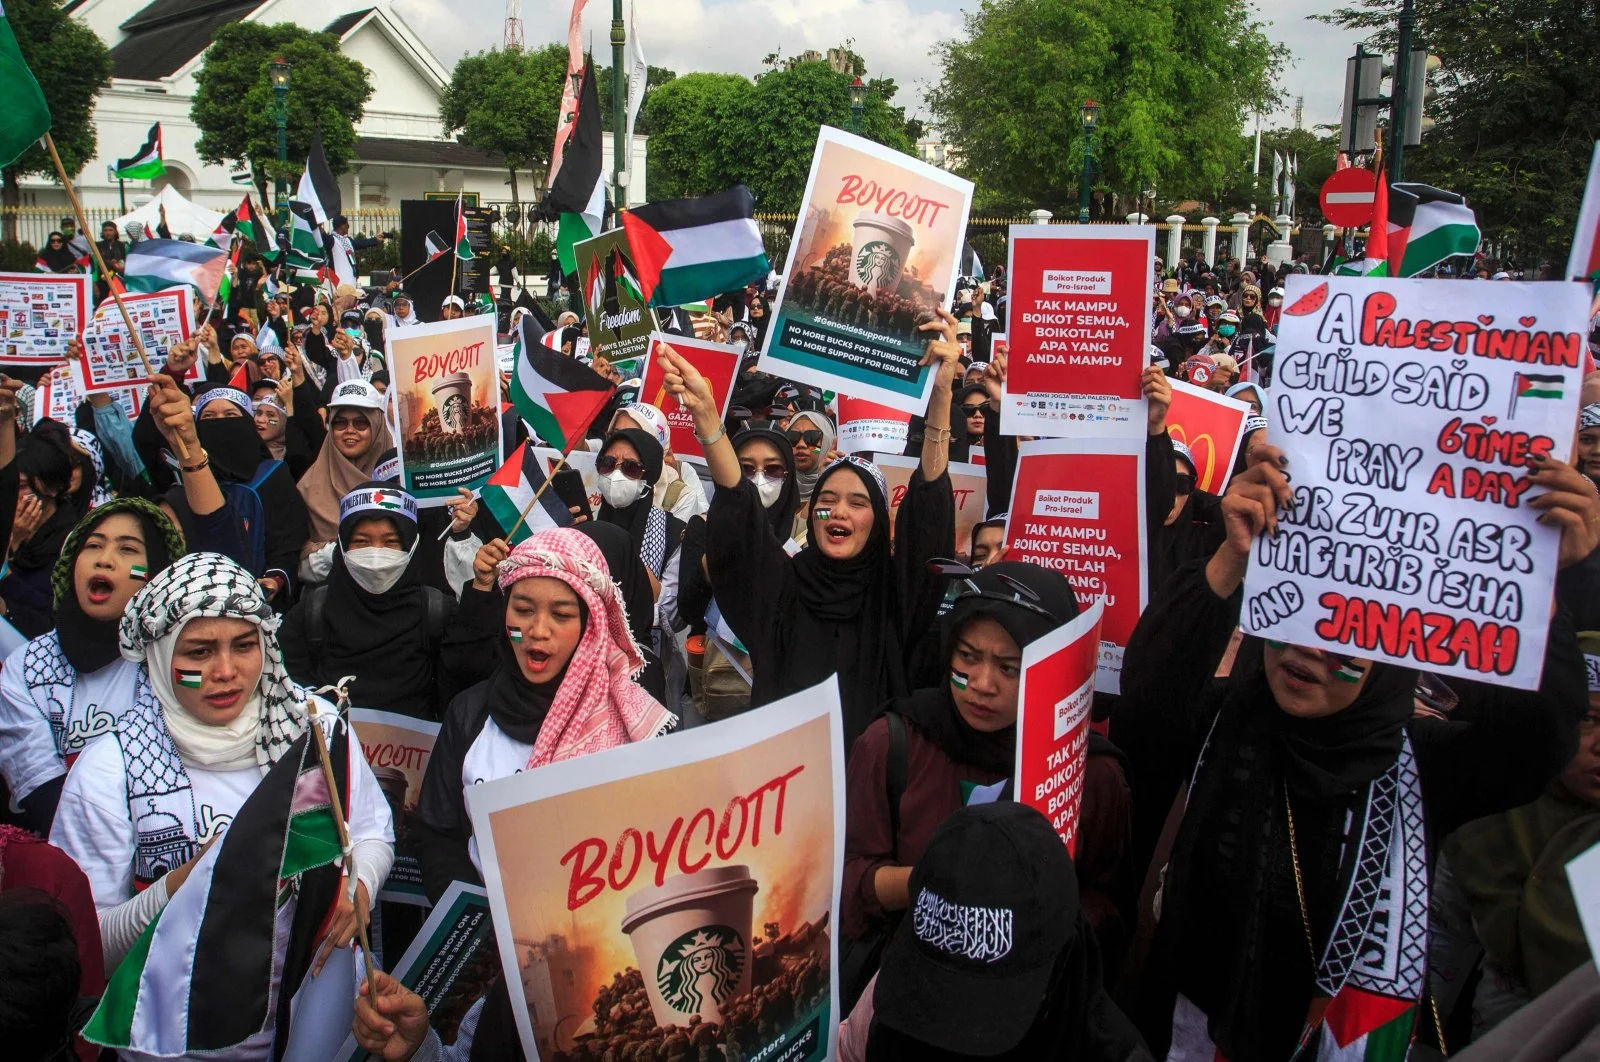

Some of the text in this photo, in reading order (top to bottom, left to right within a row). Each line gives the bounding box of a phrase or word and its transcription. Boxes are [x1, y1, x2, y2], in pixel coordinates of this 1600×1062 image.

[836, 175, 950, 228] BOYCOTT
[1047, 274, 1106, 283] Boikot Produk
[1056, 283, 1096, 291] Pro-Israel
[599, 306, 641, 331] Freedom
[1034, 299, 1118, 313] TAK MAMPU
[1319, 292, 1356, 345] A
[813, 315, 902, 346] #GenocideSupporters
[1022, 313, 1130, 328] BOIKOT SEMUA,
[618, 338, 631, 347] DUA
[632, 336, 646, 345] FOR
[788, 325, 802, 334] NO
[802, 329, 826, 342] MORE
[854, 343, 871, 354] FOR
[1035, 327, 1115, 340] BOIKOTLAH
[611, 343, 646, 356] PALESTINA
[790, 337, 909, 376] NO MORE SUPPORT FOR ISRAEL
[1039, 341, 1109, 352] APA YANG
[413, 342, 484, 383] BOYCOTT
[1026, 353, 1122, 366] ANDA MAMPU
[668, 412, 693, 421] GAZA
[1277, 394, 1344, 437] WE
[463, 466, 473, 474] FOR
[1327, 438, 1423, 491] PRAY
[447, 475, 472, 485] SUPPORT
[1426, 462, 1533, 508] A DAY
[1038, 494, 1094, 505] Boikot Produk
[1045, 504, 1082, 514] Pro-Israel
[1025, 523, 1106, 541] TAK MAMPU
[1336, 492, 1439, 555] ZUHR
[1450, 518, 1533, 574] ASR
[1013, 538, 1121, 560] BOIKOT SEMUA,
[1064, 574, 1100, 589] ANG
[1250, 579, 1304, 632] AND
[1315, 591, 1520, 676] JANAZAH
[1058, 697, 1079, 718] Boikot
[360, 742, 430, 771] YCOTT
[1046, 744, 1070, 771] TAK
[1035, 758, 1078, 801] BOIKOT
[1052, 805, 1075, 830] APA
[560, 765, 805, 911] BOYCOTT
[471, 912, 483, 926] NO
[451, 927, 473, 953] MORE
[414, 914, 470, 995] NO MORE SUPPOR
[427, 937, 481, 1016] #GenocideSuppo
[422, 985, 433, 1000] FO
